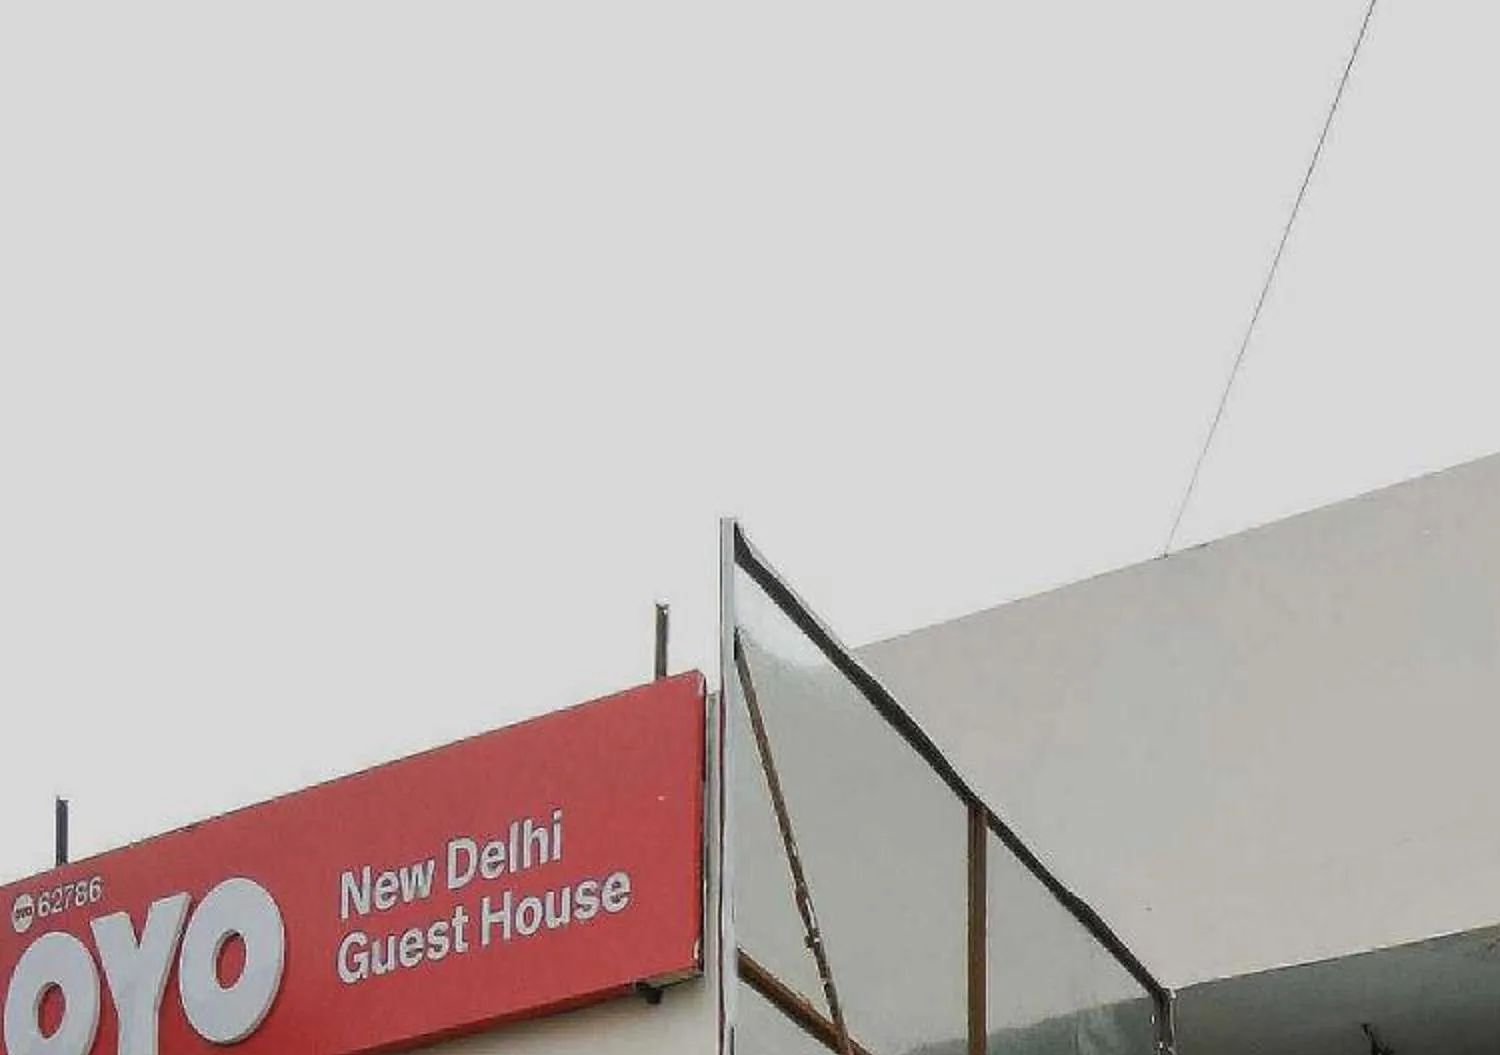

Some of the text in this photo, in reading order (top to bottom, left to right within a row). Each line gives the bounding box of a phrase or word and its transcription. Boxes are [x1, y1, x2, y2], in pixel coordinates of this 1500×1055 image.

[37, 876, 103, 917] 62786
[339, 810, 563, 920] New Delhi
[336, 869, 632, 985] Guest House
